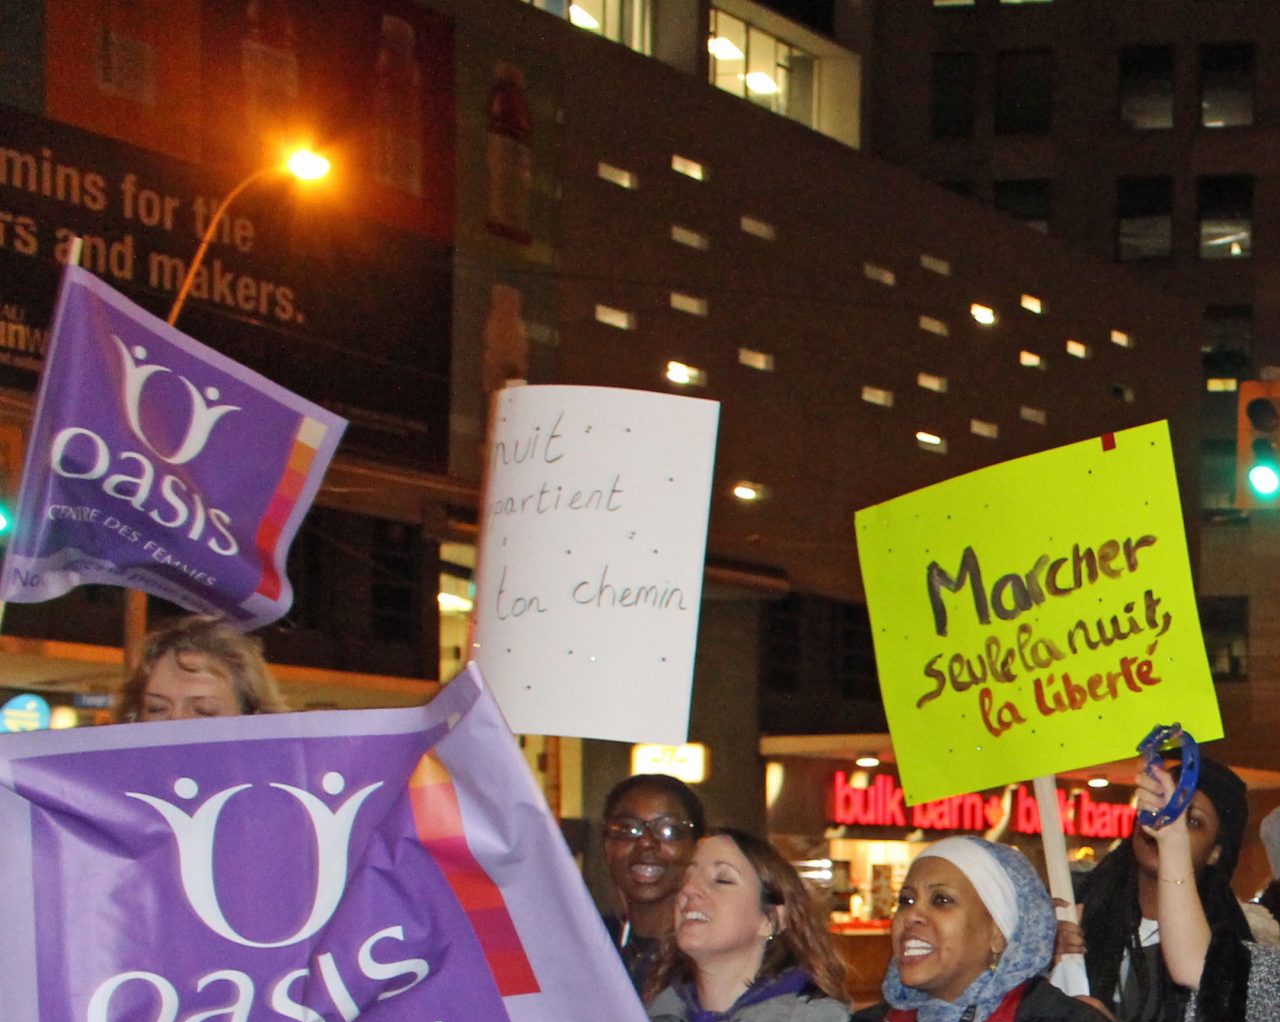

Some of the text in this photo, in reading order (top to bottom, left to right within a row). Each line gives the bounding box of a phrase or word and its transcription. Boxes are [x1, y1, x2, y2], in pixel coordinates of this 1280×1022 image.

[121, 173, 181, 231] for
[193, 197, 255, 252] the
[54, 226, 135, 280] and
[150, 251, 306, 325] makers.
[51, 427, 239, 556] oasis
[103, 516, 142, 543] DES
[496, 564, 688, 620] ton chemin
[926, 535, 1158, 637] Marcher
[979, 686, 1027, 737] la
[834, 770, 906, 827] bulk
